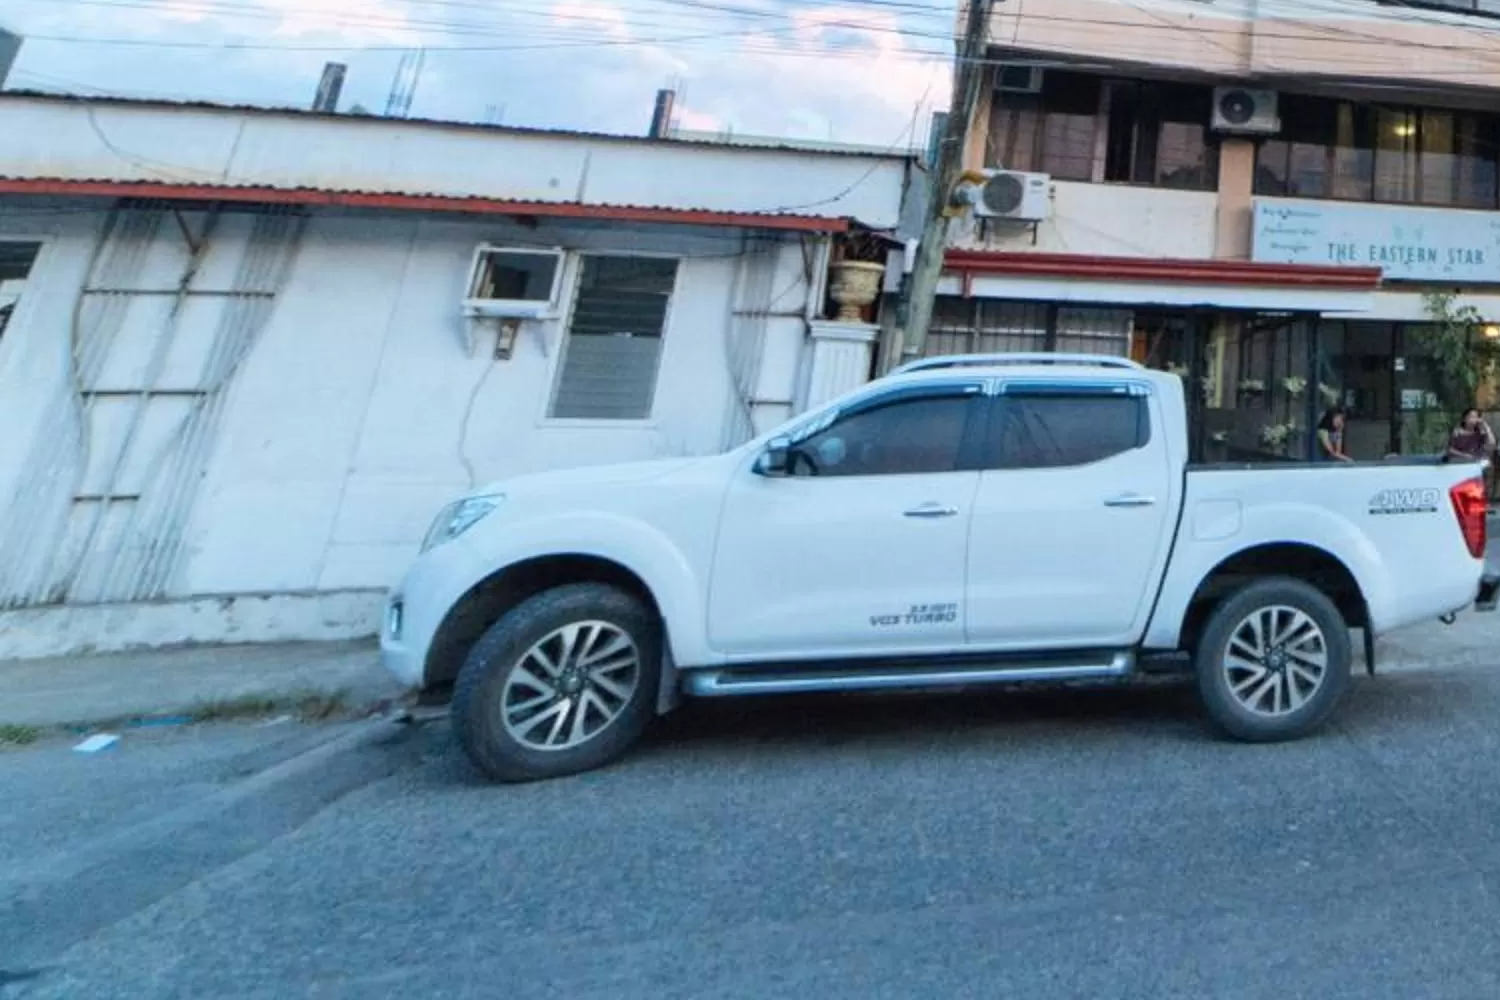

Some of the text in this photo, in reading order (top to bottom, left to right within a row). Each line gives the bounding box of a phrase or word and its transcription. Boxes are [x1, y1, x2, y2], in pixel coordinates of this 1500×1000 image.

[1328, 243, 1357, 262] THE
[1369, 244, 1438, 264] EASTERN
[1447, 247, 1484, 265] STAR
[904, 612, 957, 624] TURBO
